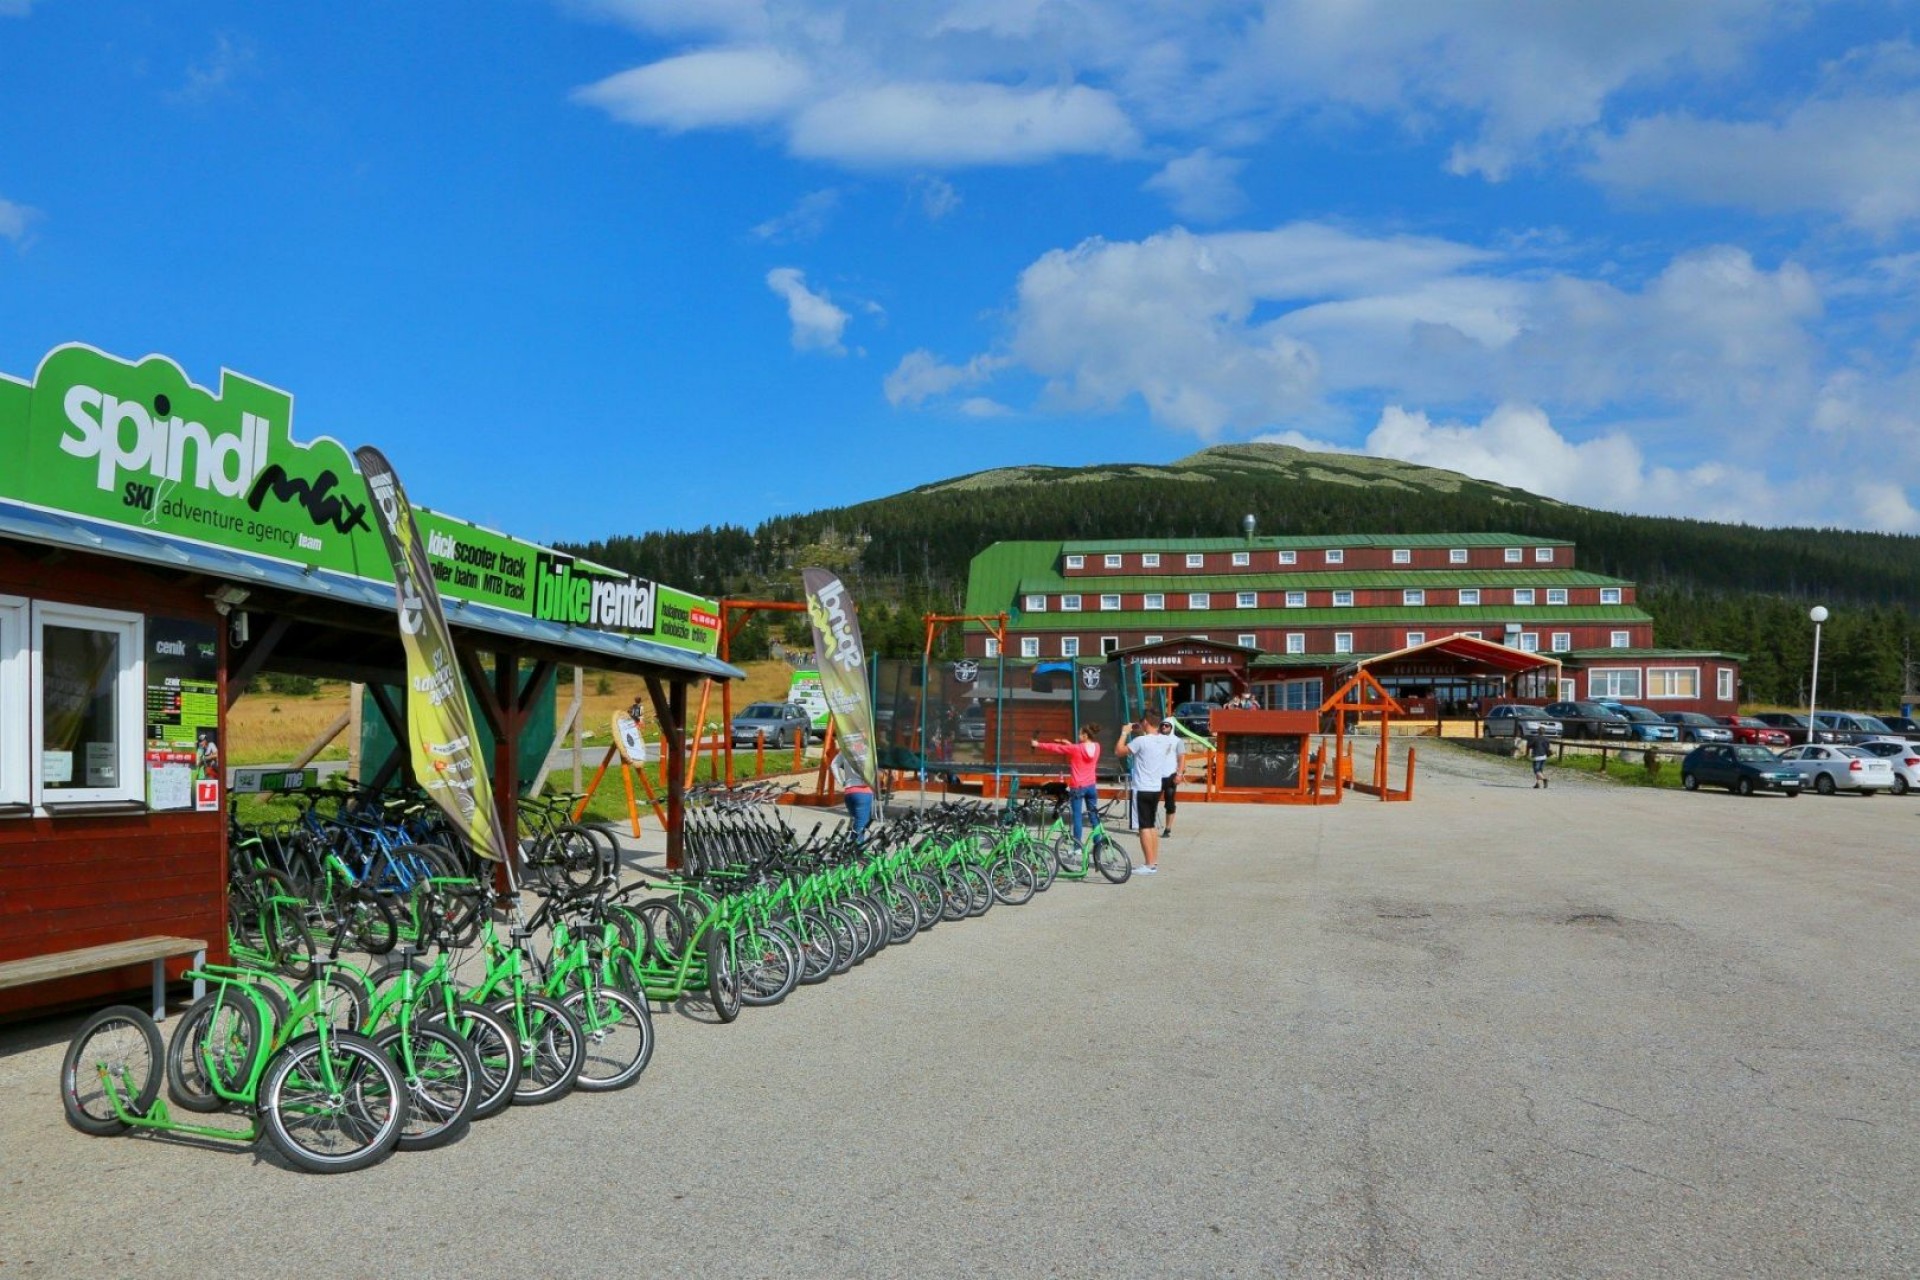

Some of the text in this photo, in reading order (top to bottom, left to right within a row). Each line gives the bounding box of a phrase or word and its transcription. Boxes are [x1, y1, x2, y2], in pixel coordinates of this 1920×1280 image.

[59, 384, 270, 499] spindl
[123, 482, 154, 510] SKI
[161, 498, 244, 532] adventure
[247, 521, 298, 549] agency
[298, 533, 322, 551] team
[430, 561, 525, 601] oller bahn MTB track
[499, 552, 526, 579] track
